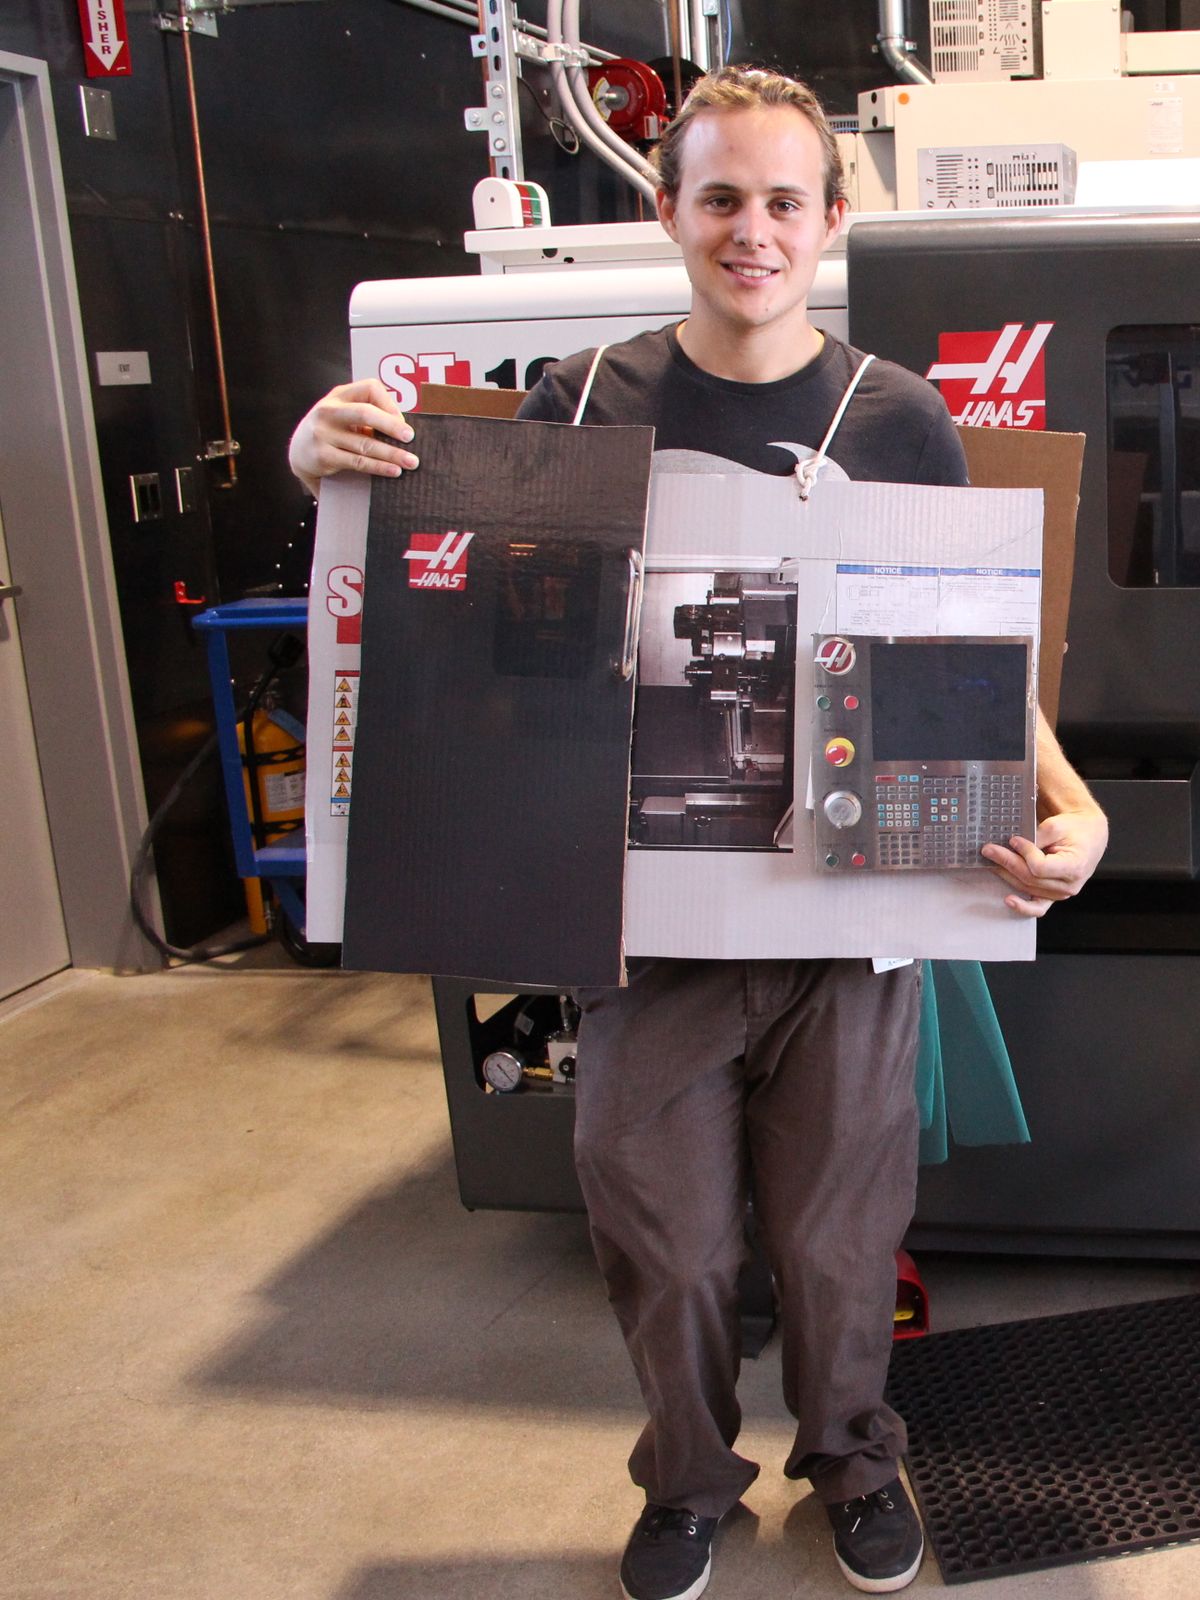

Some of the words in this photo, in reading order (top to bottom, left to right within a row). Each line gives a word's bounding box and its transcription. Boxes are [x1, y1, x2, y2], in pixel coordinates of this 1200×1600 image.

[951, 399, 1046, 427] HAAS
[874, 567, 902, 575] NOTICE
[975, 568, 1003, 576] NOTICE
[409, 571, 467, 588] HAAS
